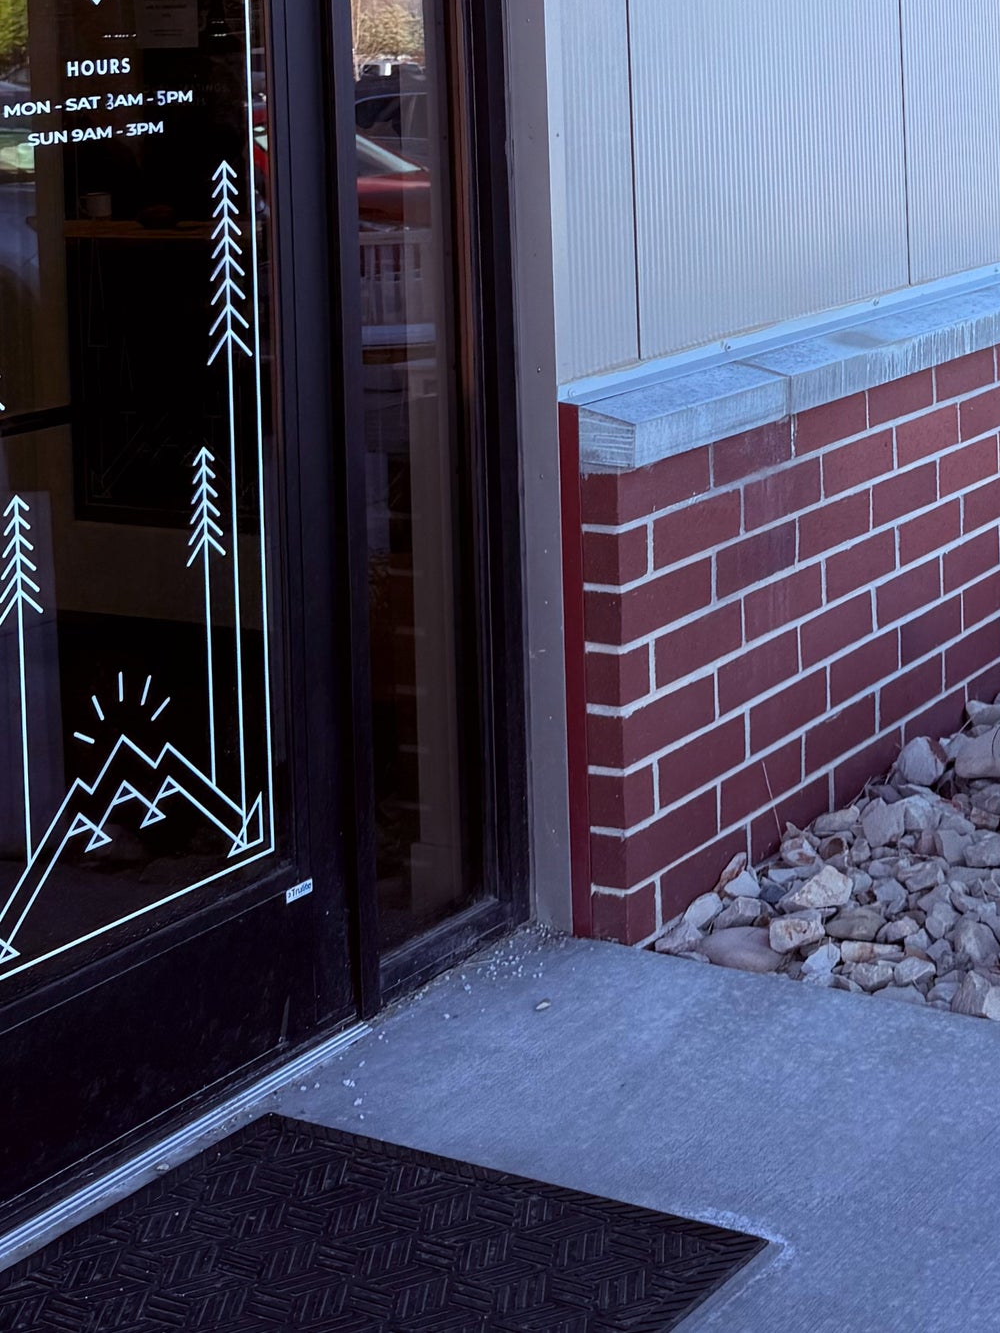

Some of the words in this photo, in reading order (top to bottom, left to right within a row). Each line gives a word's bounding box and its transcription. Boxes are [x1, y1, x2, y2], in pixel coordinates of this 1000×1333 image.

[66, 57, 131, 77] HOURS
[3, 100, 51, 118] MON
[65, 95, 102, 112] SAT
[157, 89, 193, 106] 5PM
[27, 129, 68, 147] SUN
[71, 125, 113, 142] 9AM
[125, 120, 164, 137] 3PM
